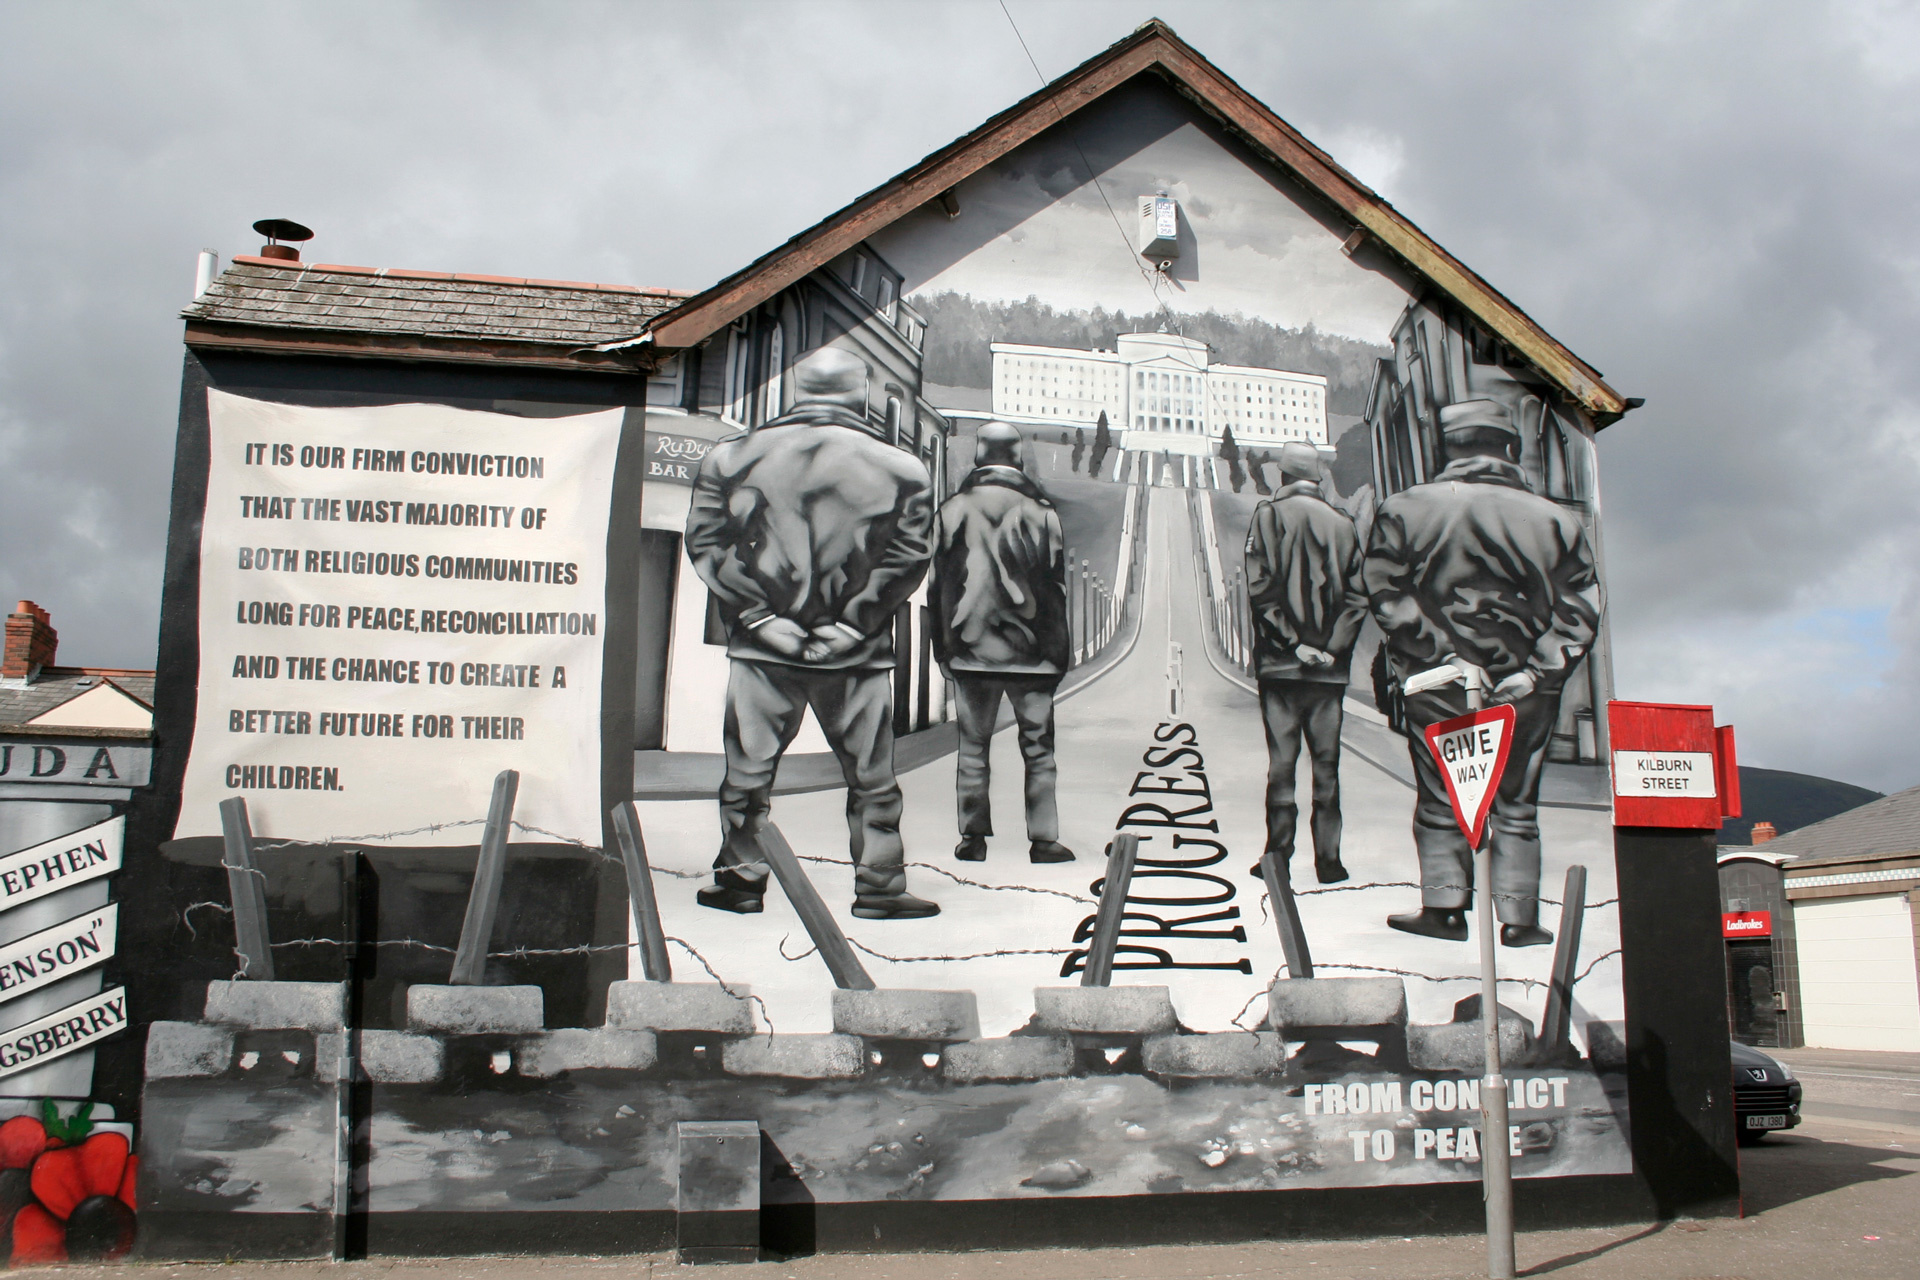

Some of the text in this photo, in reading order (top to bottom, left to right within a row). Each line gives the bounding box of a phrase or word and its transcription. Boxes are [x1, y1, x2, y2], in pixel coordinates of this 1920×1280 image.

[245, 442, 544, 478] IT IS OUR FIRM CONVICTION
[648, 462, 690, 479] BAR
[240, 495, 547, 530] THAT THE VAST MAJORITY OF
[238, 547, 578, 585] BOTH RELIGIOUS COMMUNITIES
[237, 600, 294, 626] LONG
[298, 603, 341, 628] FOR
[232, 654, 567, 689] AND THE CHANCE TO CREATE A
[229, 709, 524, 740] BETTER FUTURE FOR THEIR
[1443, 728, 1494, 763] GIVE
[225, 763, 344, 792] CHILDREN.
[1456, 762, 1488, 784] WAY
[1637, 759, 1693, 771] KILBURN
[1642, 777, 1689, 790] STREET
[1060, 722, 1253, 978] PROGRESS
[1726, 918, 1764, 931] Ladbrokes
[1304, 1077, 1569, 1115] FROM CONICT
[1348, 1125, 1522, 1162] TO PEAE
